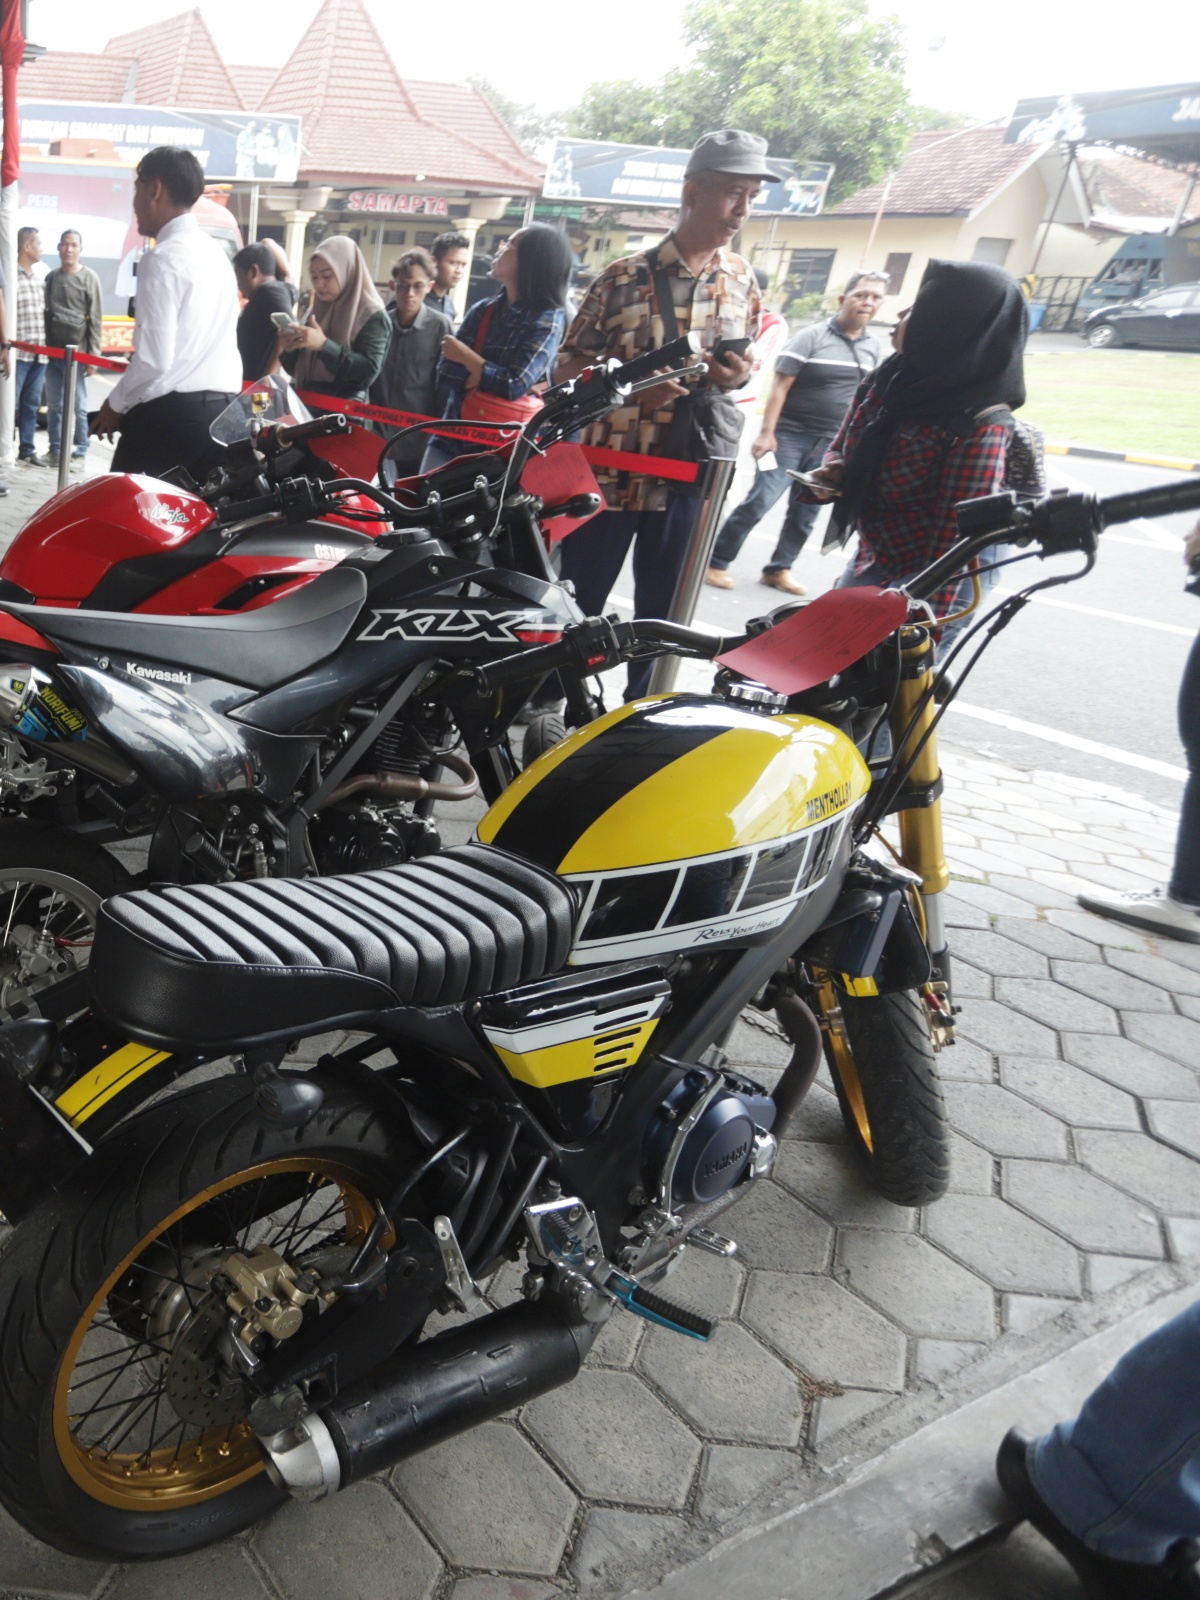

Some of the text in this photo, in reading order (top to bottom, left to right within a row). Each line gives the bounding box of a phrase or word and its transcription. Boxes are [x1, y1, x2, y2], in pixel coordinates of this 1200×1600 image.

[125, 124, 150, 144] DAN
[347, 191, 449, 216] SAMAPTA
[150, 503, 190, 524] Ninja
[355, 609, 542, 643] KLX
[126, 661, 192, 686] Kawasaki
[40, 685, 84, 732] NORIFUMI
[729, 924, 757, 939] Your
[755, 917, 781, 931] Heart
[703, 1141, 749, 1178] YAMAHA
